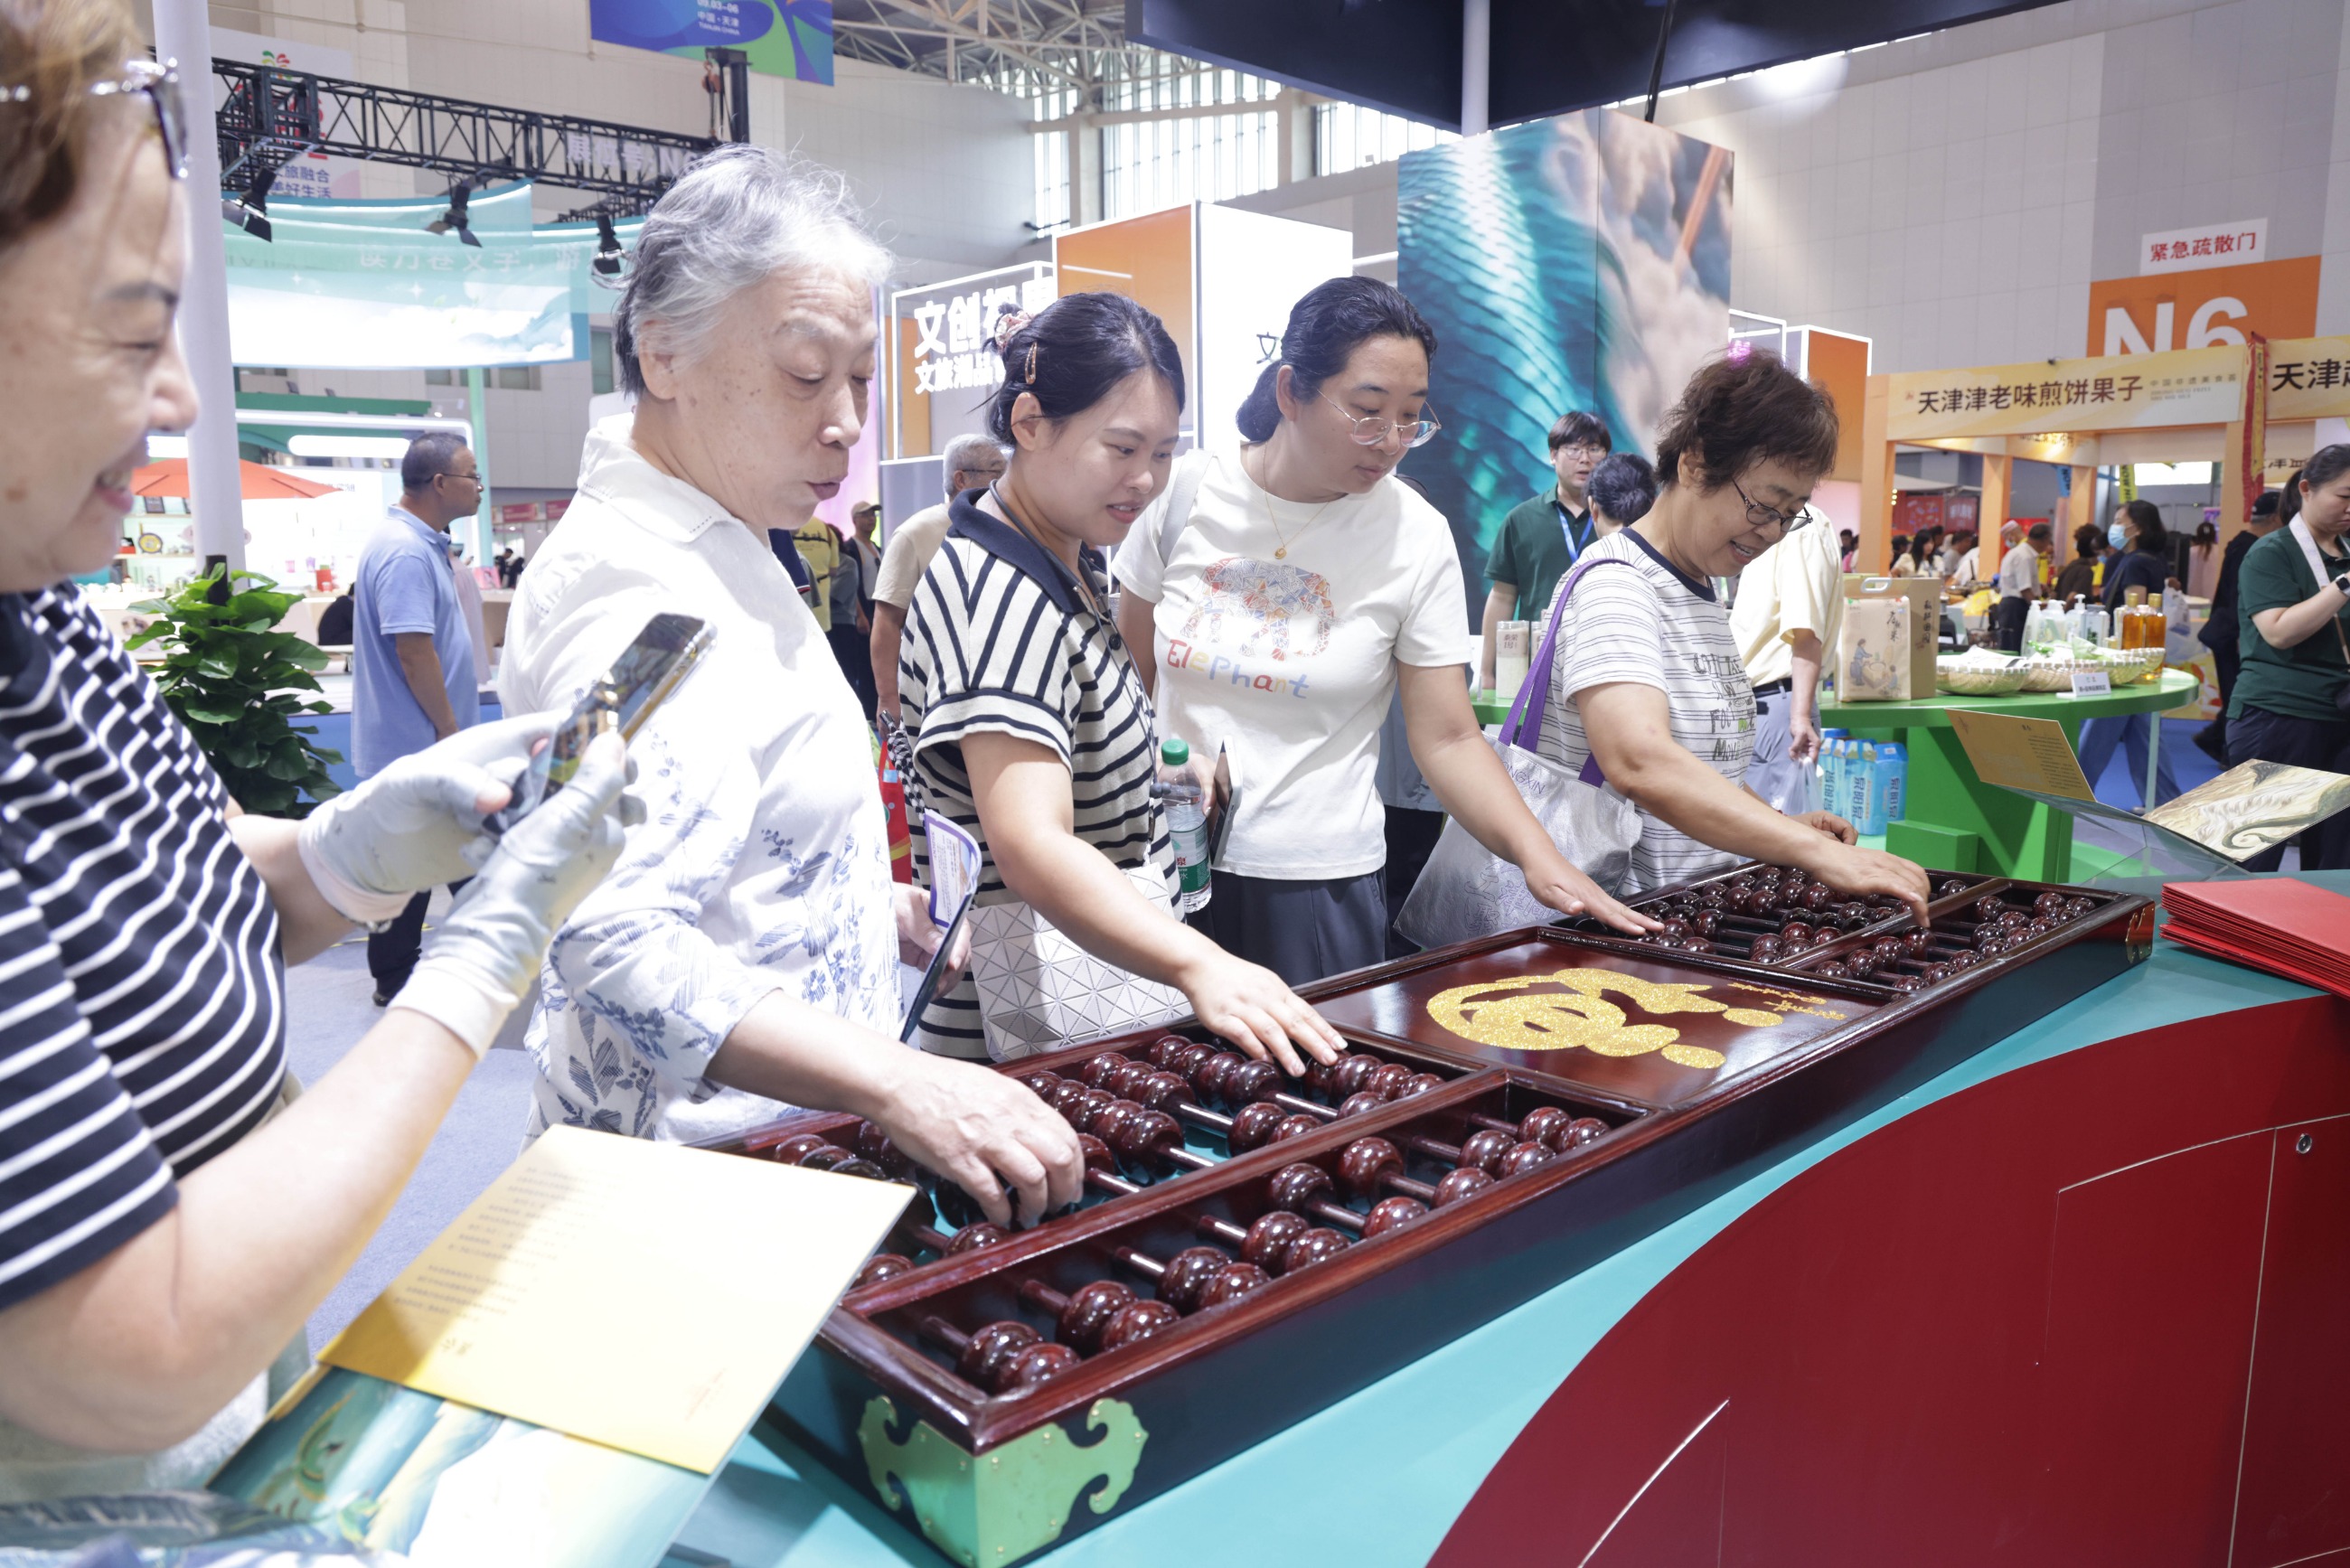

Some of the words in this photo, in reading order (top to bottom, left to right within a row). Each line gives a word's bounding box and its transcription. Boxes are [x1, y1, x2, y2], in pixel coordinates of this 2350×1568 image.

[275, 164, 330, 183] 旅融合
[2150, 231, 2257, 262] 紧急疏散门
[2103, 296, 2248, 357] N6
[1918, 376, 2143, 415] 天津津老味煎饼果子
[1852, 777, 1866, 820] 泉阳泉
